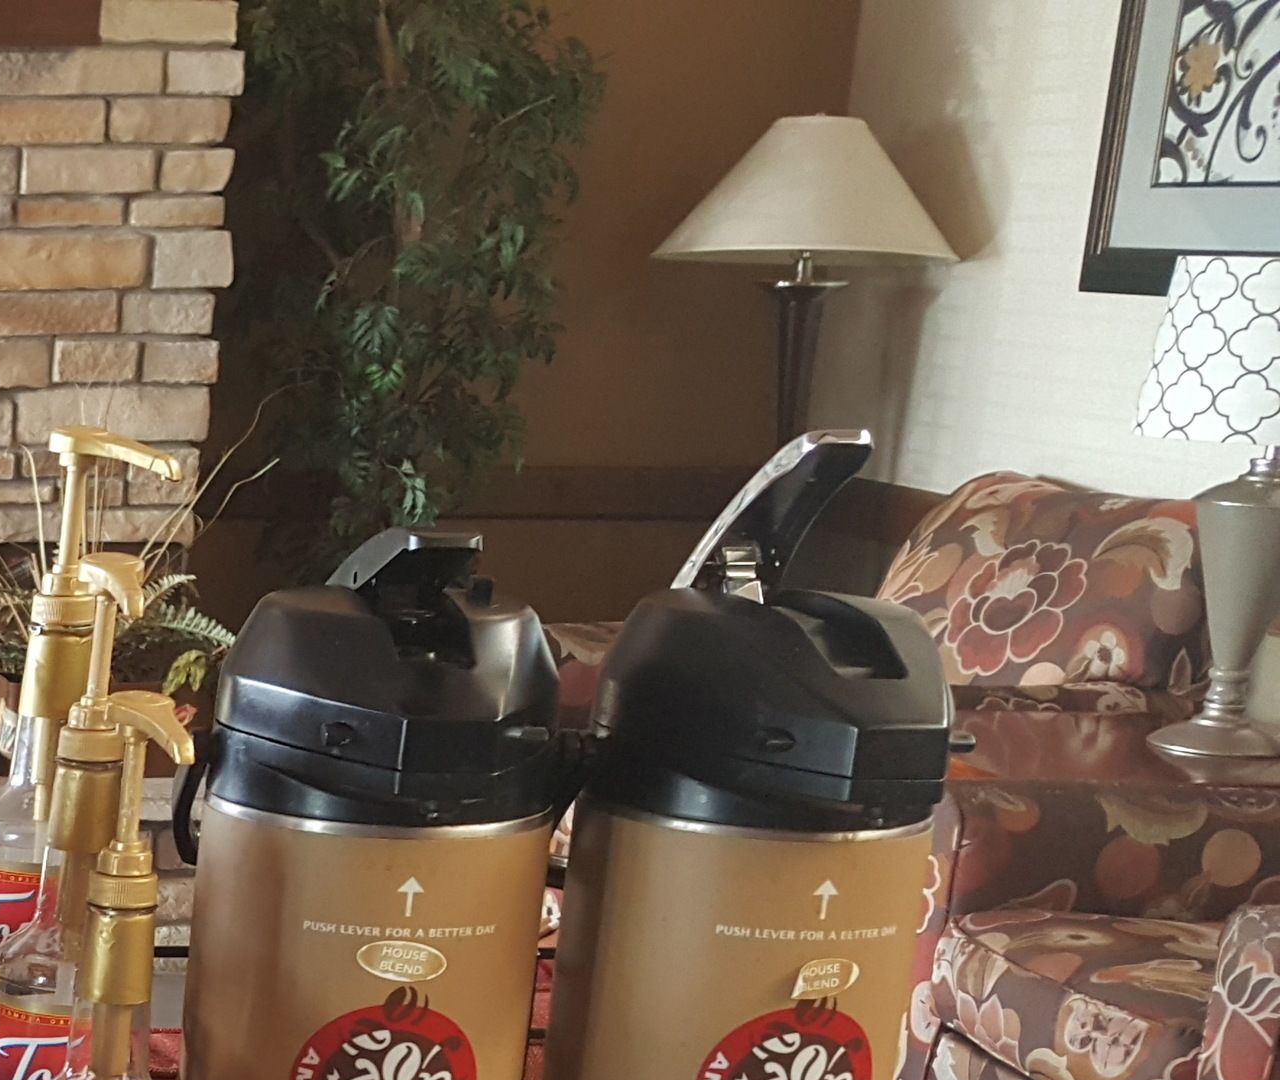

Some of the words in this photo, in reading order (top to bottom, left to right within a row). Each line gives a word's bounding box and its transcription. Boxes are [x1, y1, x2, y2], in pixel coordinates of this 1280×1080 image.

[303, 920, 336, 934] PUSH
[340, 923, 381, 937] LEVER
[384, 926, 411, 939] FOR
[414, 928, 425, 938] A
[428, 926, 473, 939] BETTER
[475, 924, 497, 936] DAY
[715, 923, 751, 939] PUSH
[755, 926, 795, 940] LEVER
[799, 928, 825, 941] FOR
[827, 930, 837, 940] A
[380, 946, 428, 962] HOUSE
[379, 960, 424, 976] BLEND
[801, 963, 841, 978] HOUSE
[800, 977, 840, 991] BLEND
